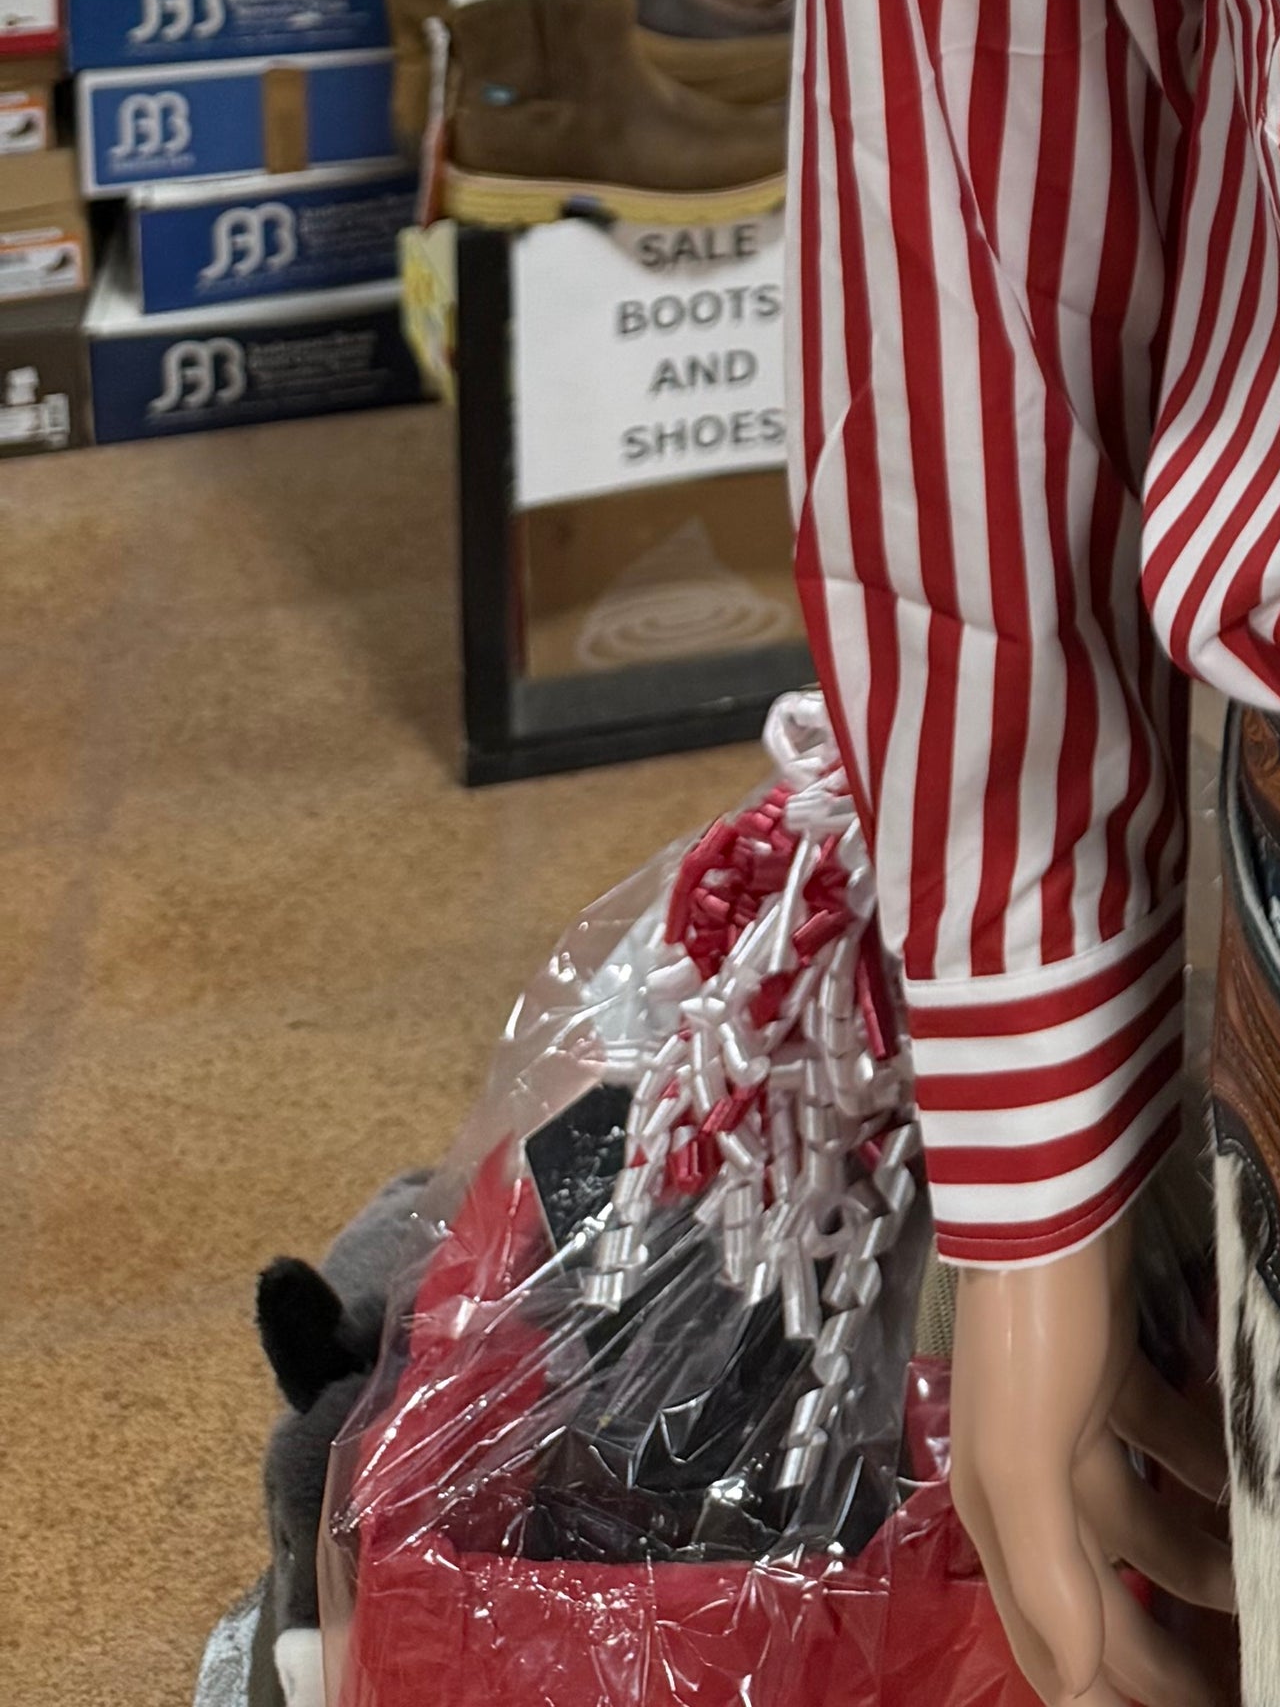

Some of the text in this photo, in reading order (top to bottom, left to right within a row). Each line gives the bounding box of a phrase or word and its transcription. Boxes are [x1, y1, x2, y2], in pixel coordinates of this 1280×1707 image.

[639, 224, 758, 269] SALE
[617, 284, 782, 337] BOOTS
[649, 348, 758, 396] AND
[621, 407, 786, 463] SHOES
